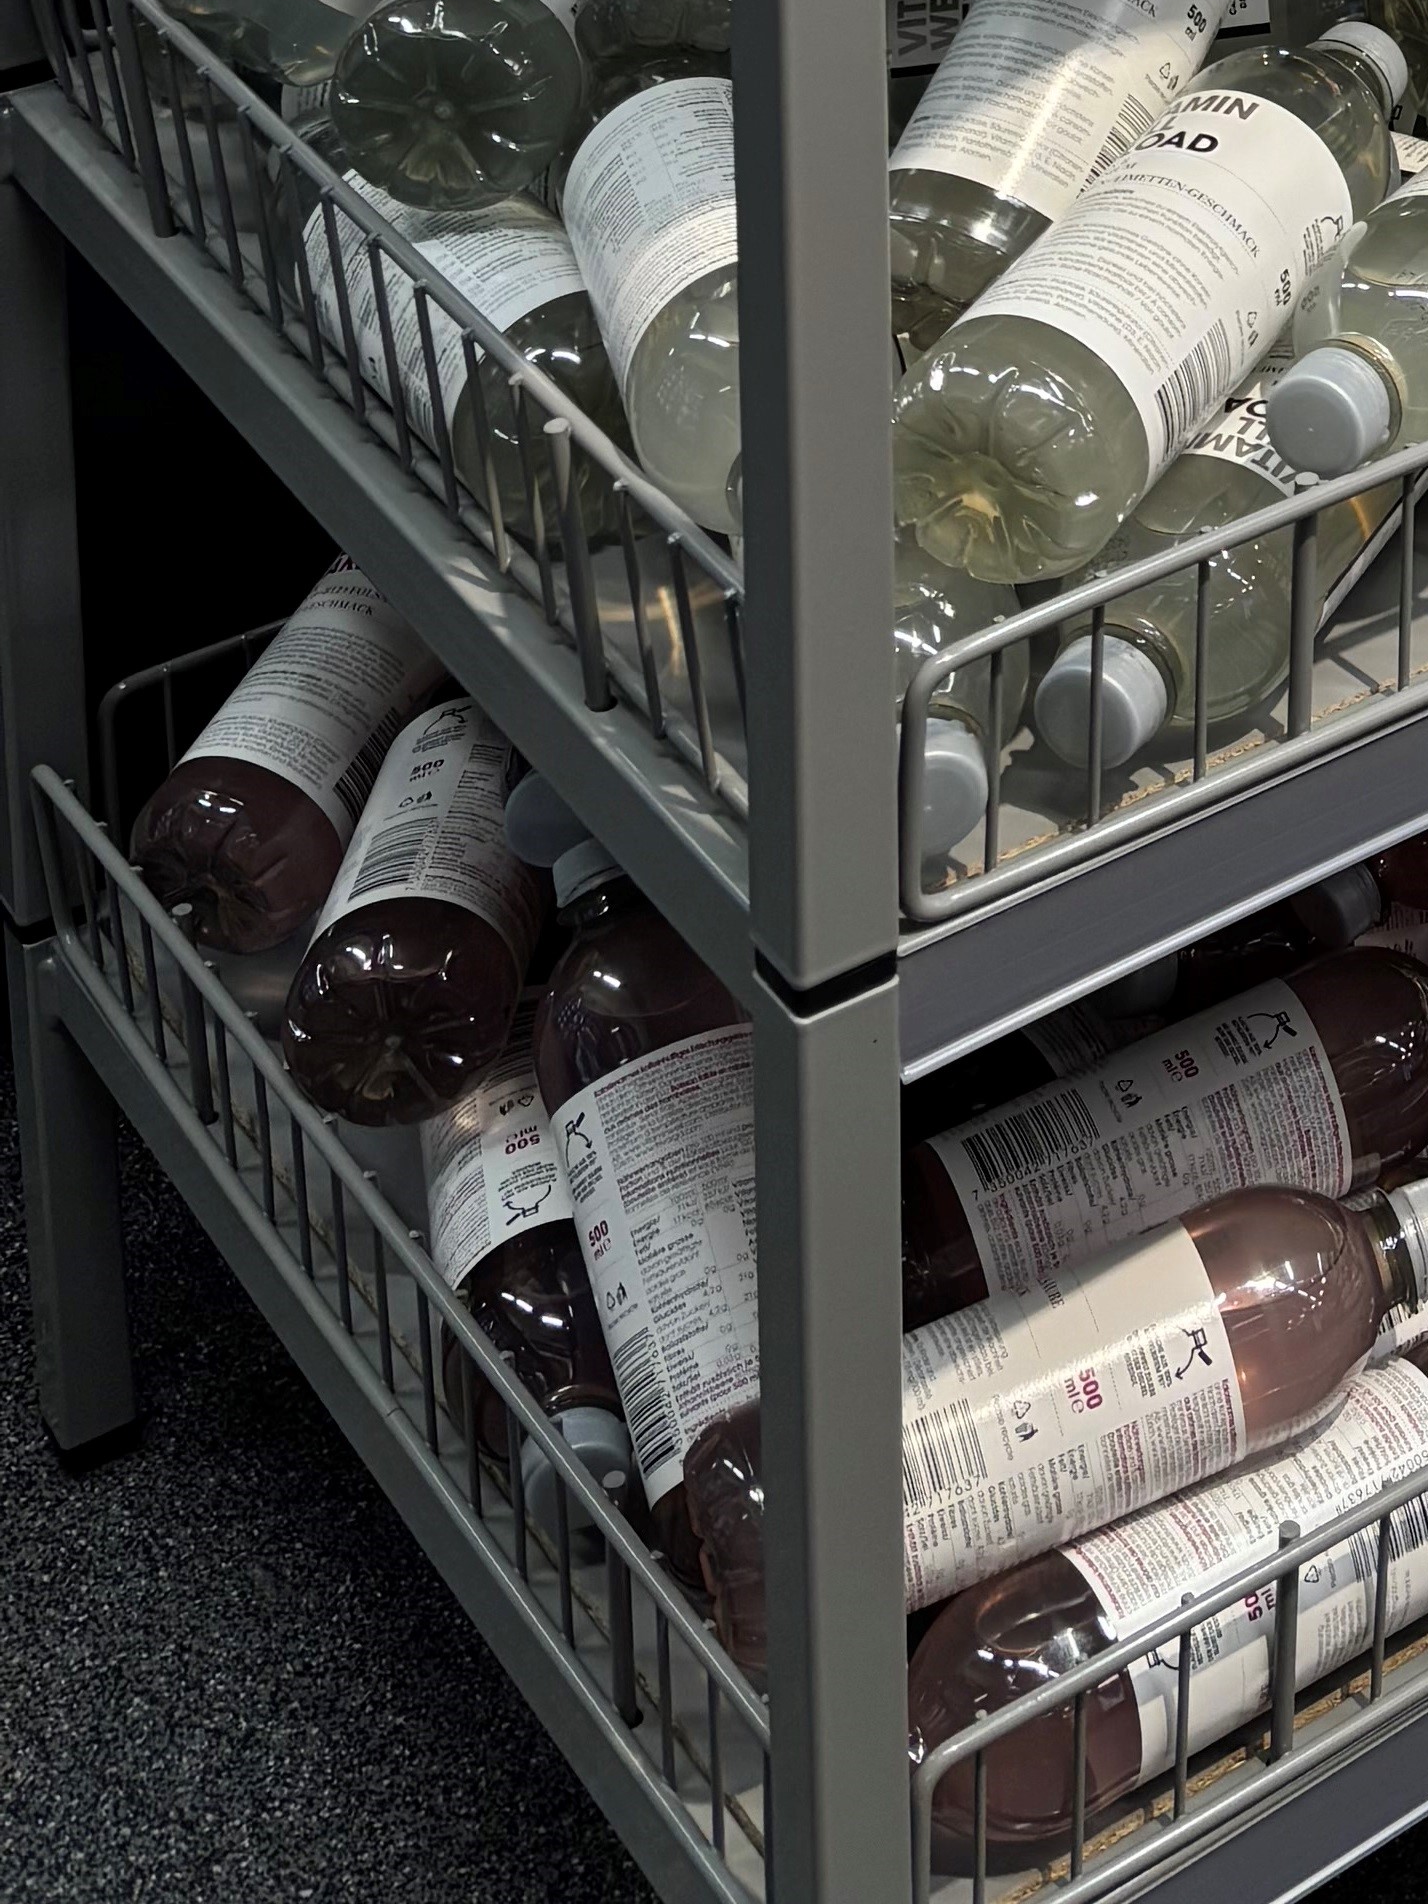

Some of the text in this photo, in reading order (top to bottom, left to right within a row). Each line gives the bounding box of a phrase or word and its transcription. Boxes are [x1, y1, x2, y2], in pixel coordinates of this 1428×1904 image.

[1187, 4, 1207, 34] 500
[1171, 1048, 1198, 1080] 500
[1078, 1366, 1105, 1412] 500
